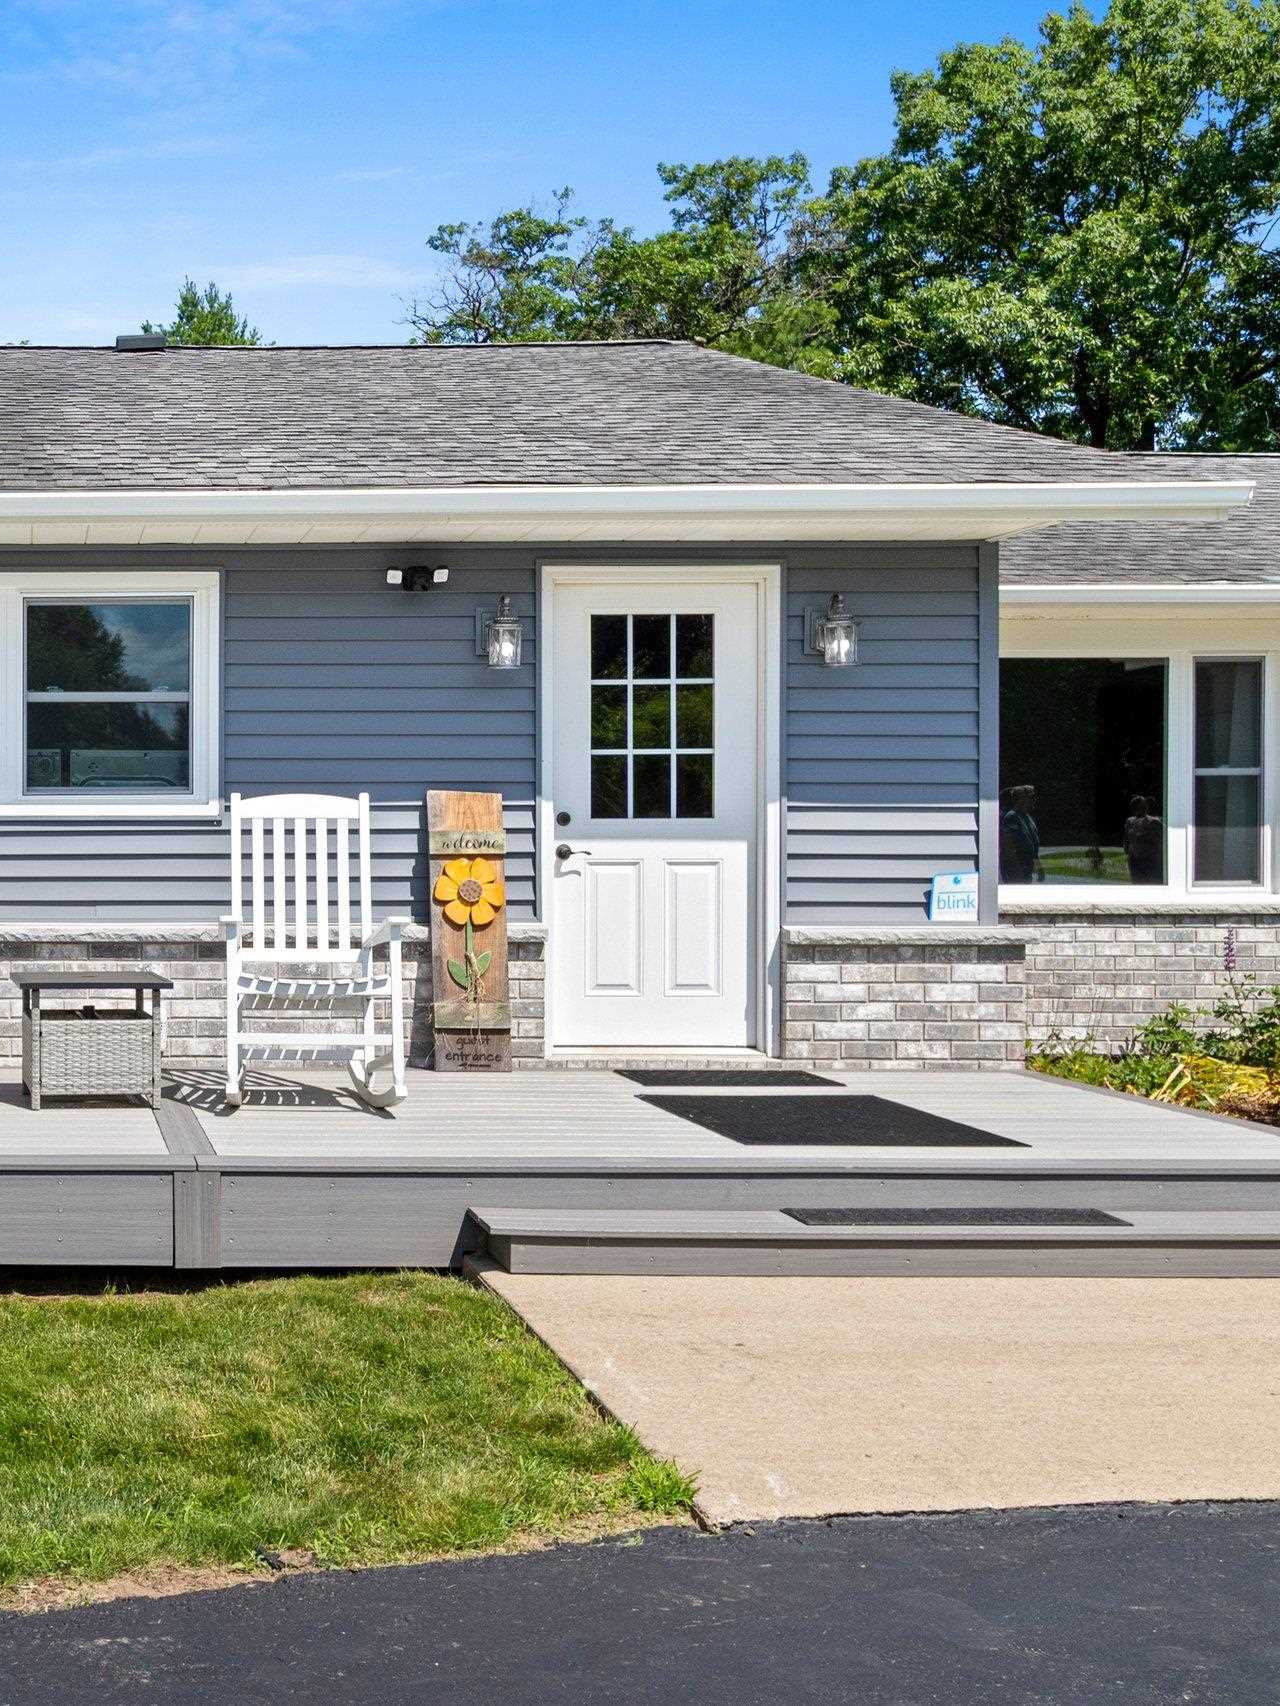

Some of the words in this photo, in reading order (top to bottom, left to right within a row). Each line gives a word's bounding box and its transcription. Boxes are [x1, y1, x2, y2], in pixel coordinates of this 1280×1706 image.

[441, 832, 502, 849] welcome
[937, 894, 976, 909] blink
[445, 1051, 502, 1062] entrance
